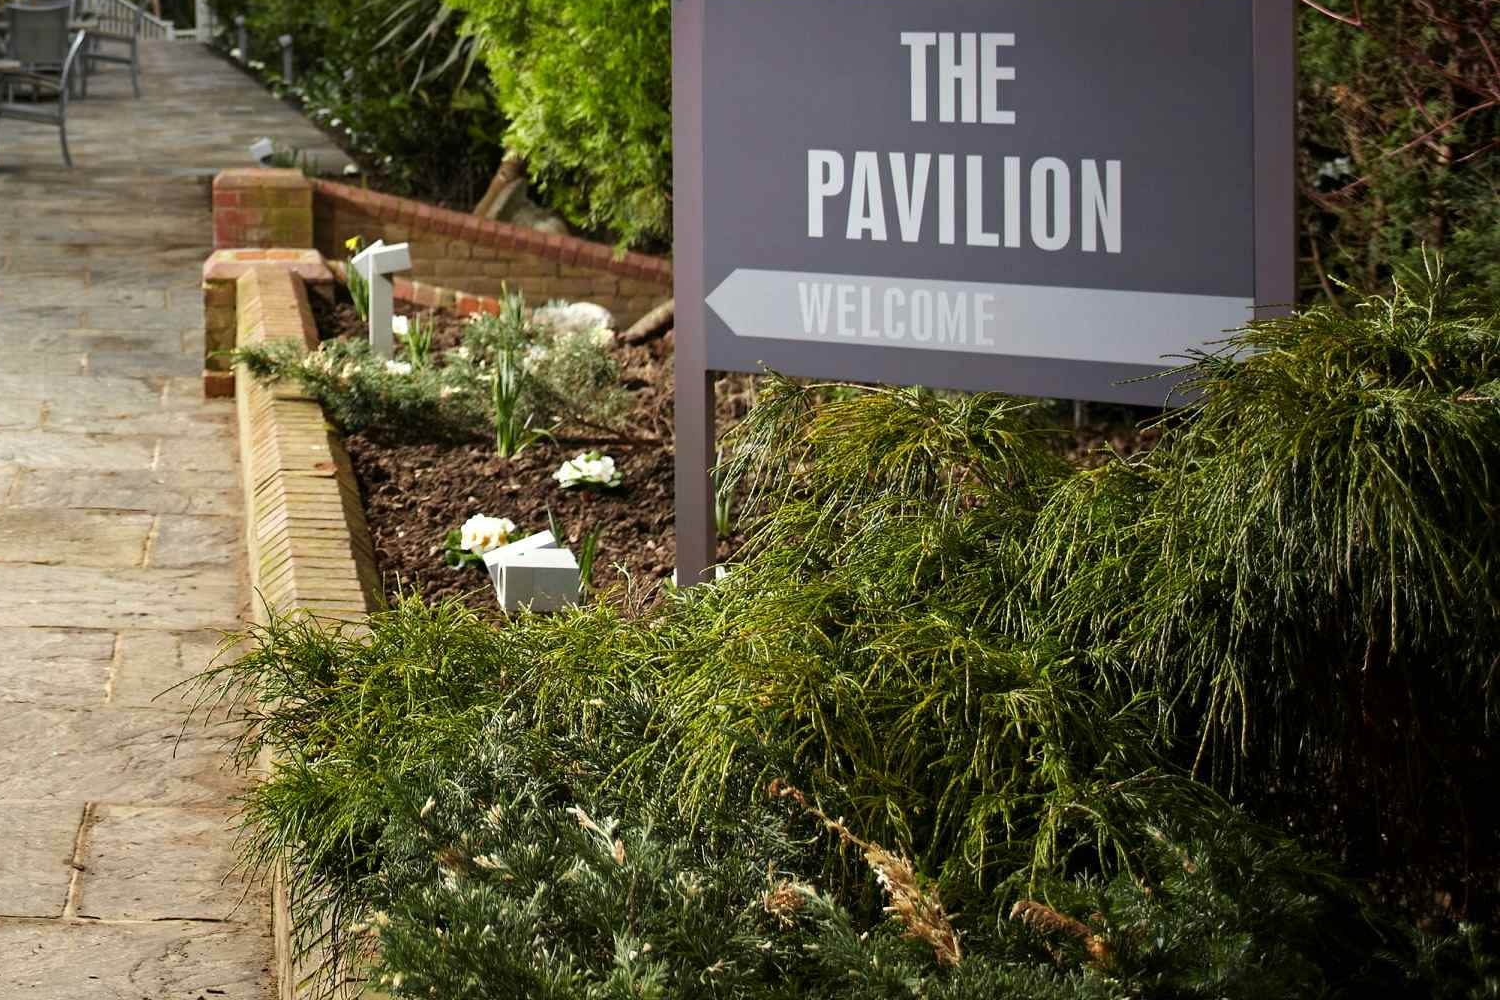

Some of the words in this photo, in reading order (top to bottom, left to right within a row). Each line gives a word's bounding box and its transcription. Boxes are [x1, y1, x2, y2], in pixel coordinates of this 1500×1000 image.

[900, 31, 1016, 125] THE
[807, 148, 1123, 254] PAVILION
[797, 280, 996, 347] WELCOME
